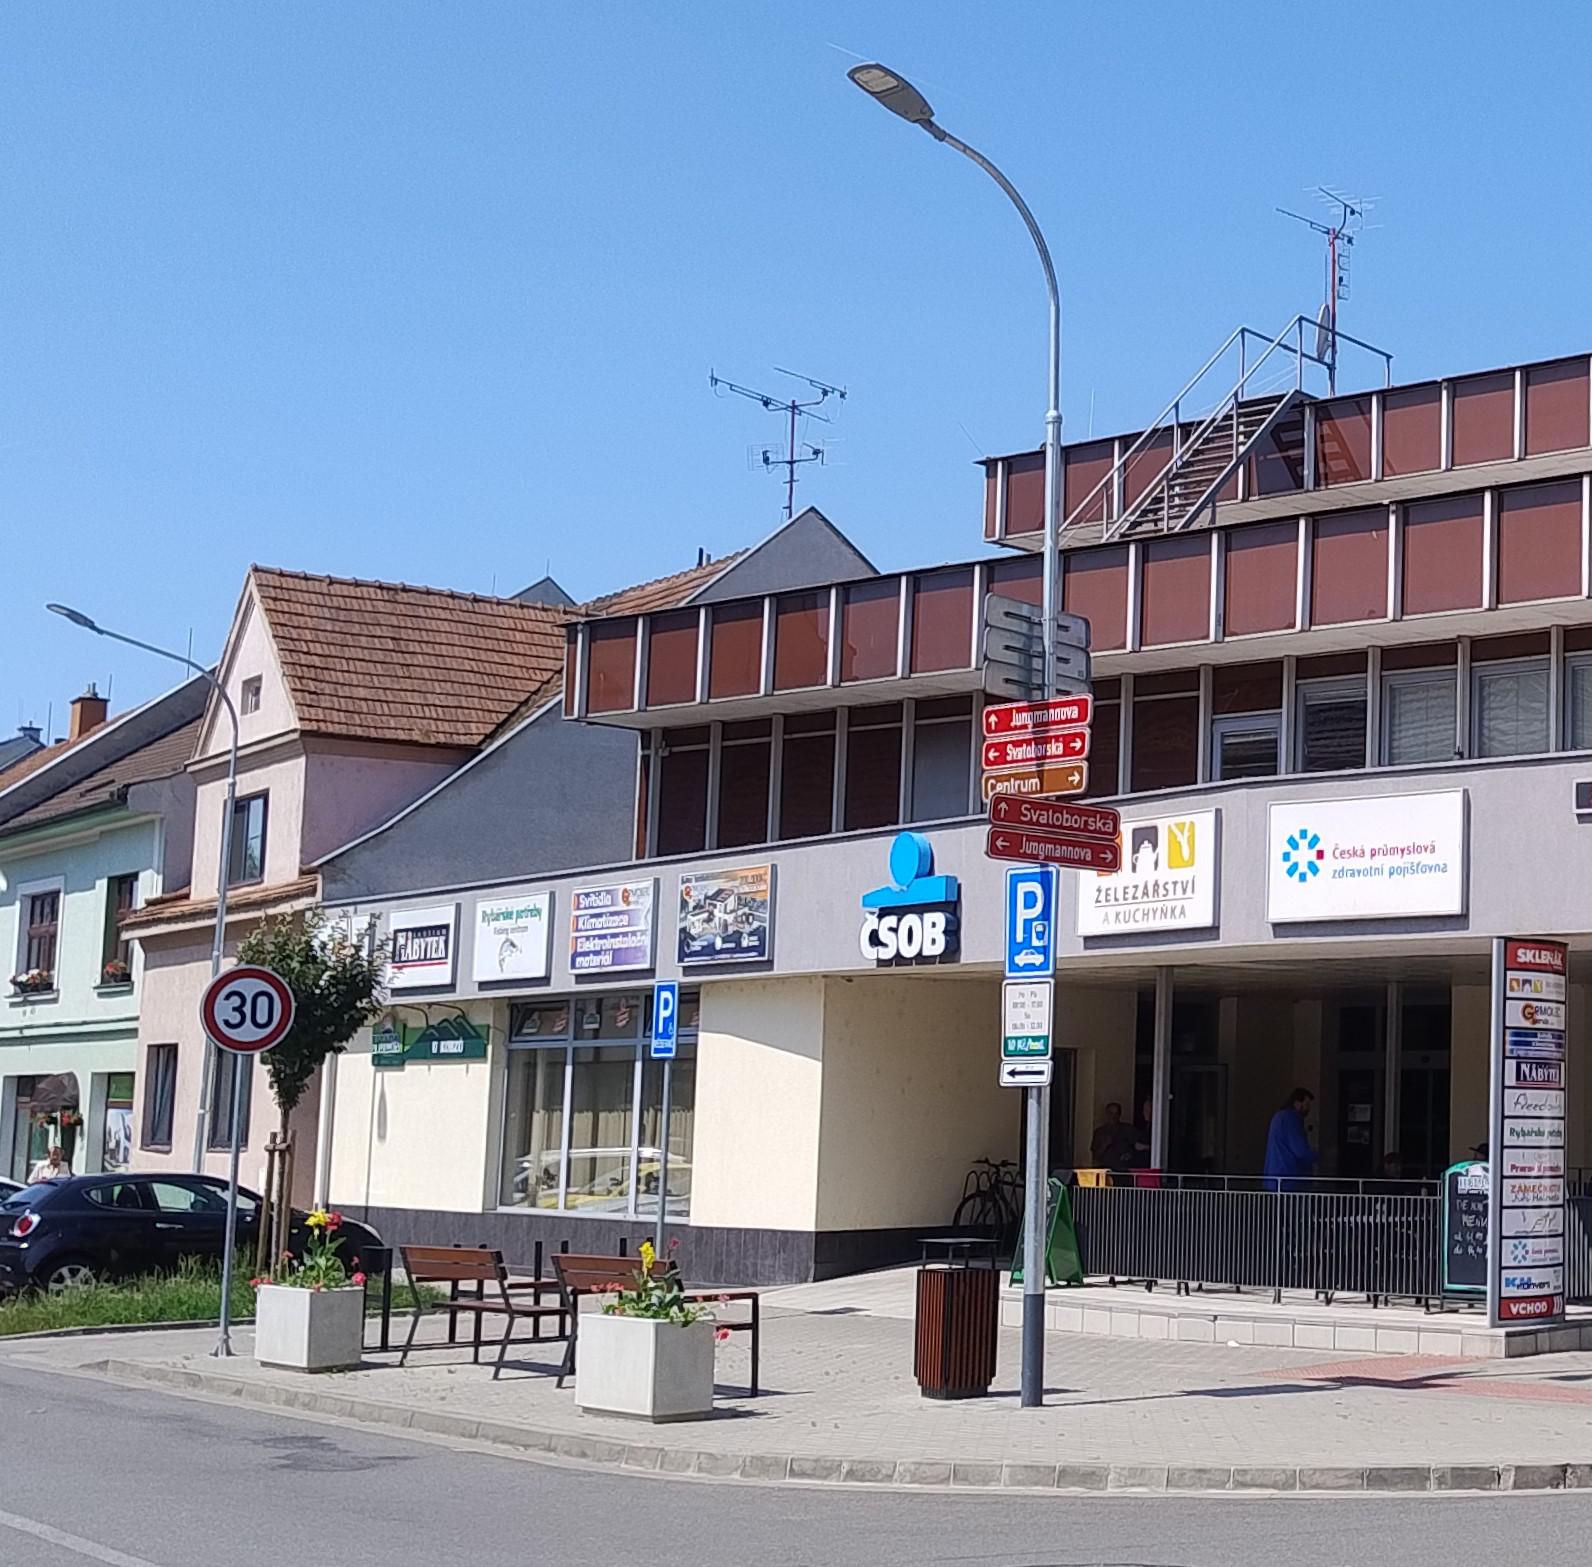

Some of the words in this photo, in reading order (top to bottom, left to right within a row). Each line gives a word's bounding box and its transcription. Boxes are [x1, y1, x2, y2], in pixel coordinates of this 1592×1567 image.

[1010, 705, 1079, 731] Jungmannova
[1006, 737, 1064, 762] Svatoborská
[987, 775, 1041, 795] Centrum
[1020, 804, 1114, 833] Svatoborská
[1019, 834, 1093, 861] Jungmannova
[1332, 842, 1366, 859] Česká
[1370, 840, 1436, 860] průmyslová
[1331, 863, 1384, 879] zdravotní
[1388, 861, 1449, 879] pojišťovna
[1094, 875, 1196, 904] ŽELEZÁŘSTVÍ
[1015, 882, 1044, 943] P
[1114, 903, 1187, 924] KUCHYŇKA
[860, 911, 946, 960] ČSOB
[222, 990, 274, 1030] 30
[658, 991, 673, 1034] P
[1509, 1301, 1548, 1315] VCHOD
